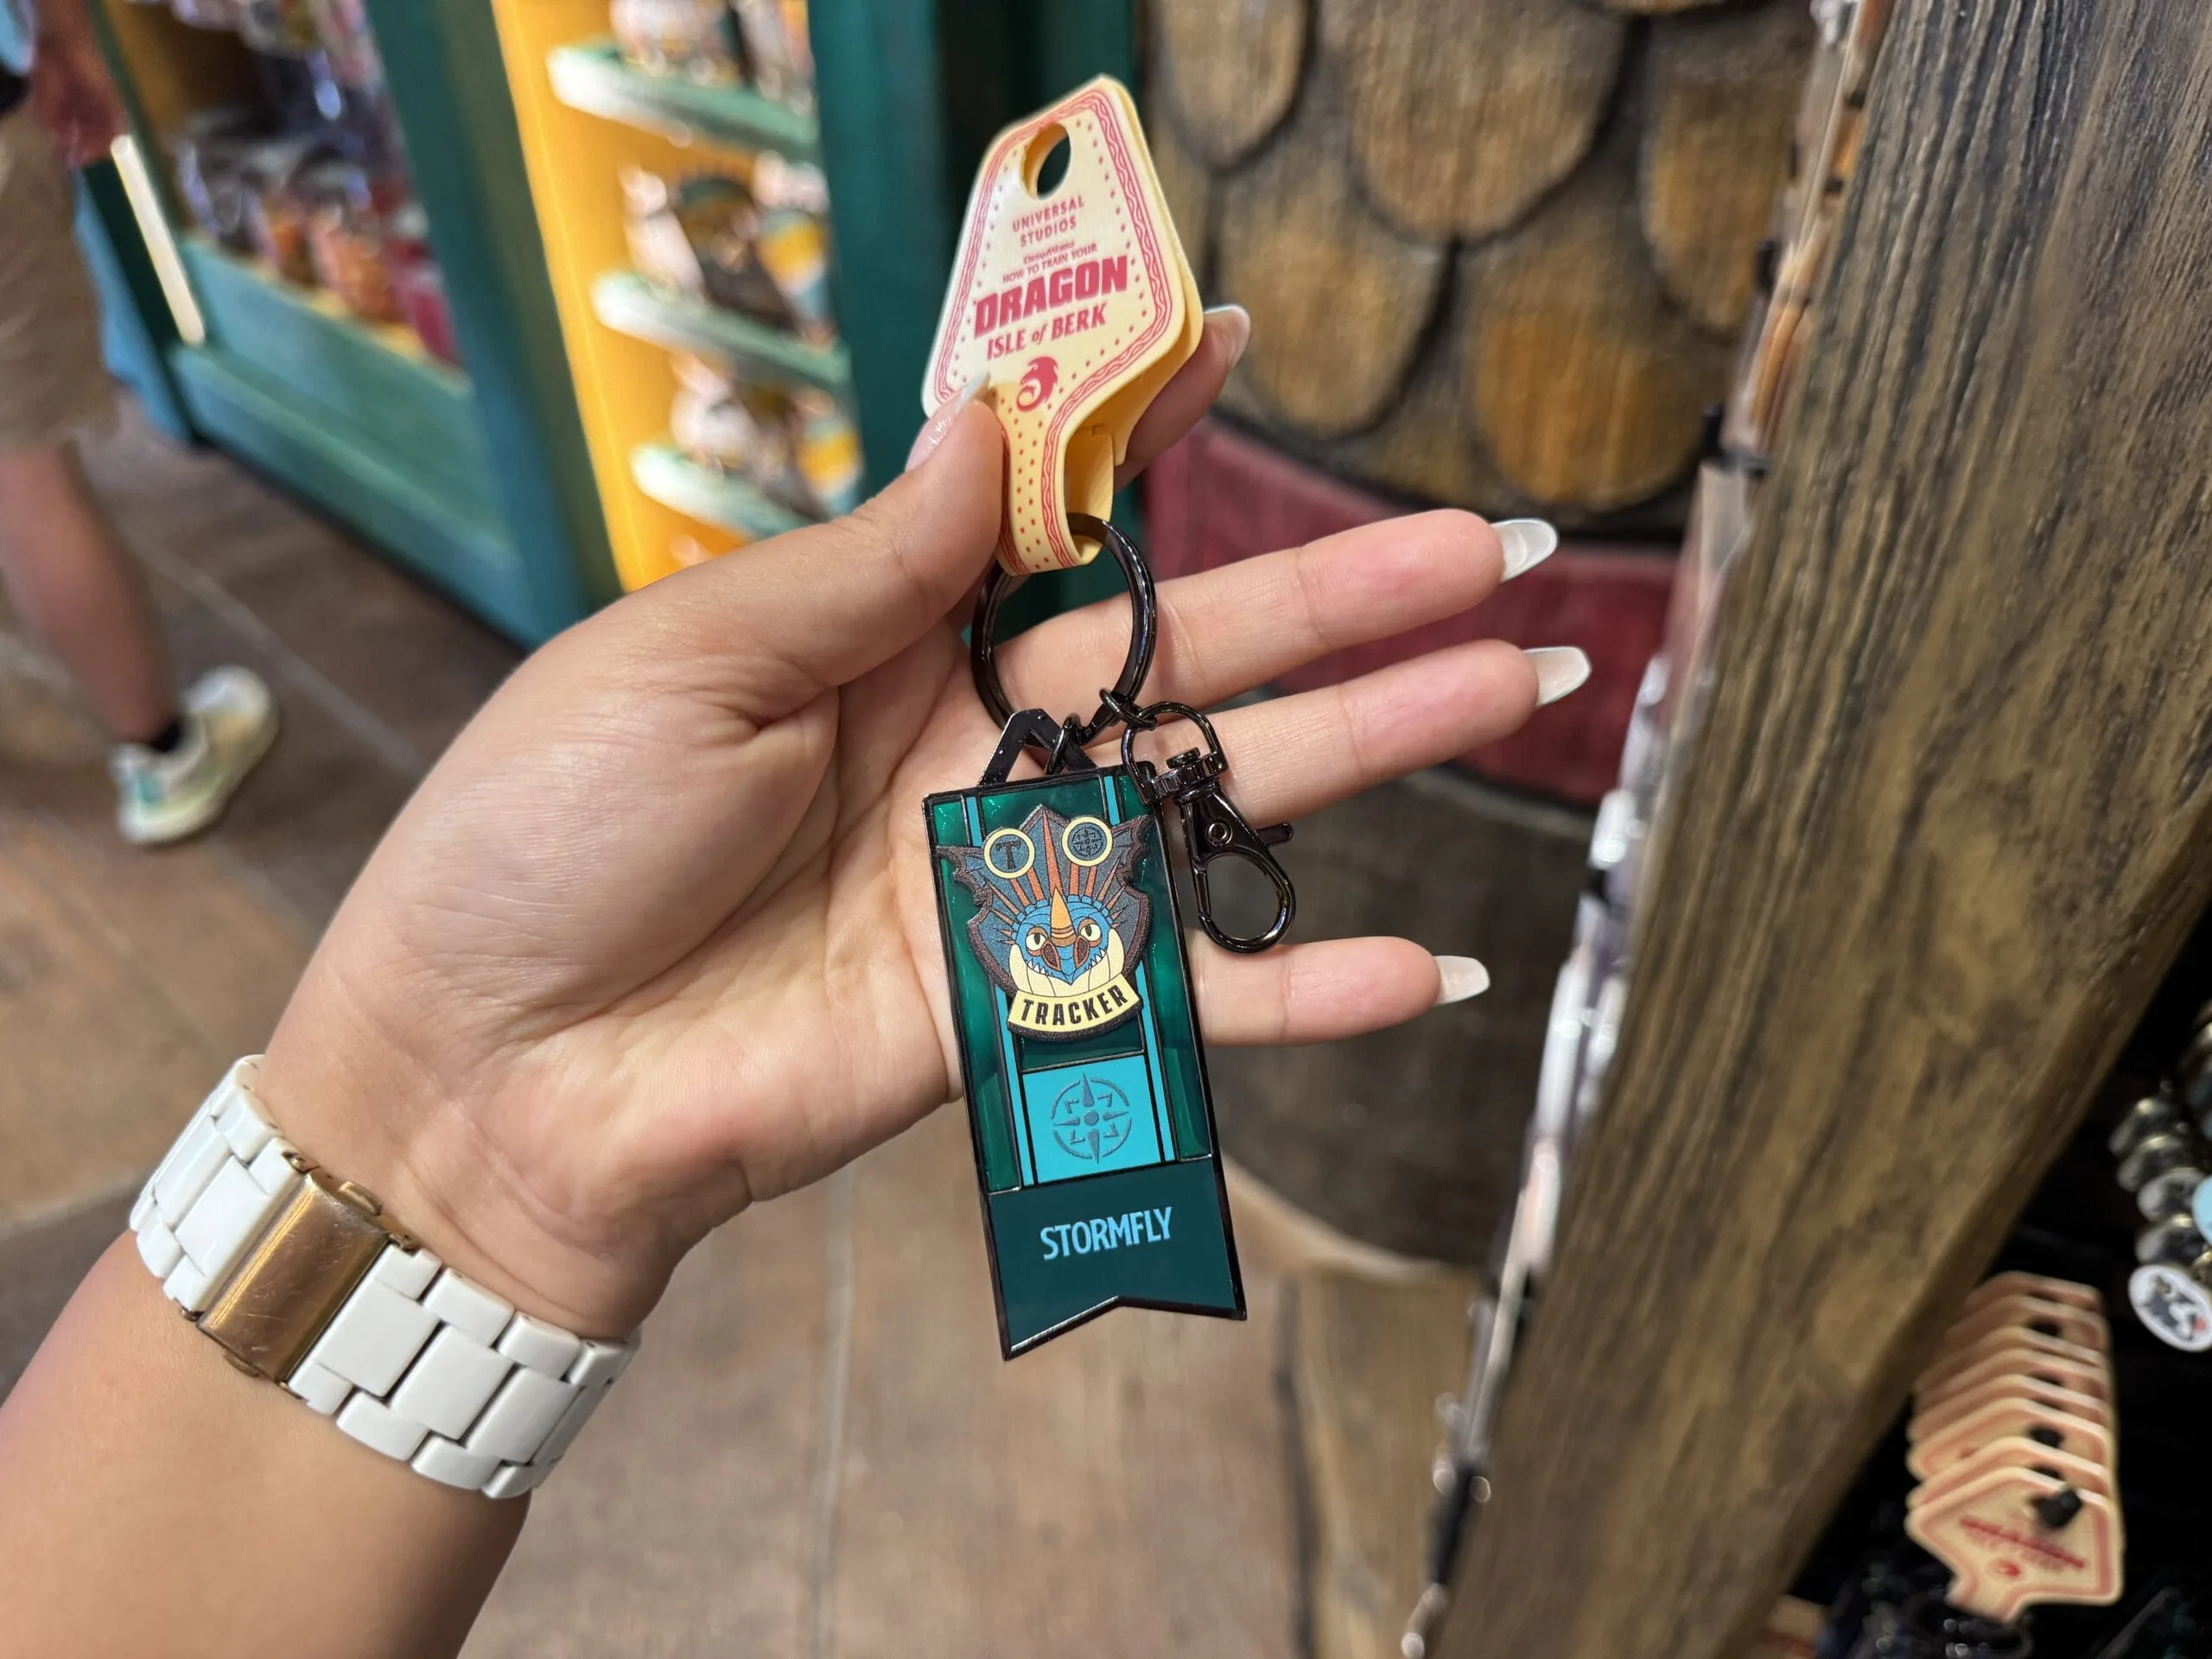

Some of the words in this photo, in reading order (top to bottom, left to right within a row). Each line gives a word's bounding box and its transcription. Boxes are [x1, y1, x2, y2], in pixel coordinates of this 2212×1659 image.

[1012, 194, 1085, 232] UNIVERSAL
[1020, 214, 1077, 247] STUDIOS
[1002, 268, 1025, 284] HOW
[1027, 264, 1040, 276] TO
[1041, 253, 1069, 270] TRAIN
[1071, 242, 1097, 260] YOUR
[974, 255, 1128, 340] DRAGON
[987, 328, 1027, 360] ISLE
[1032, 322, 1048, 346] of
[1050, 302, 1108, 341] BERK
[1020, 984, 1128, 1026] TRACKER
[1039, 1206, 1173, 1261] STORMFLY
